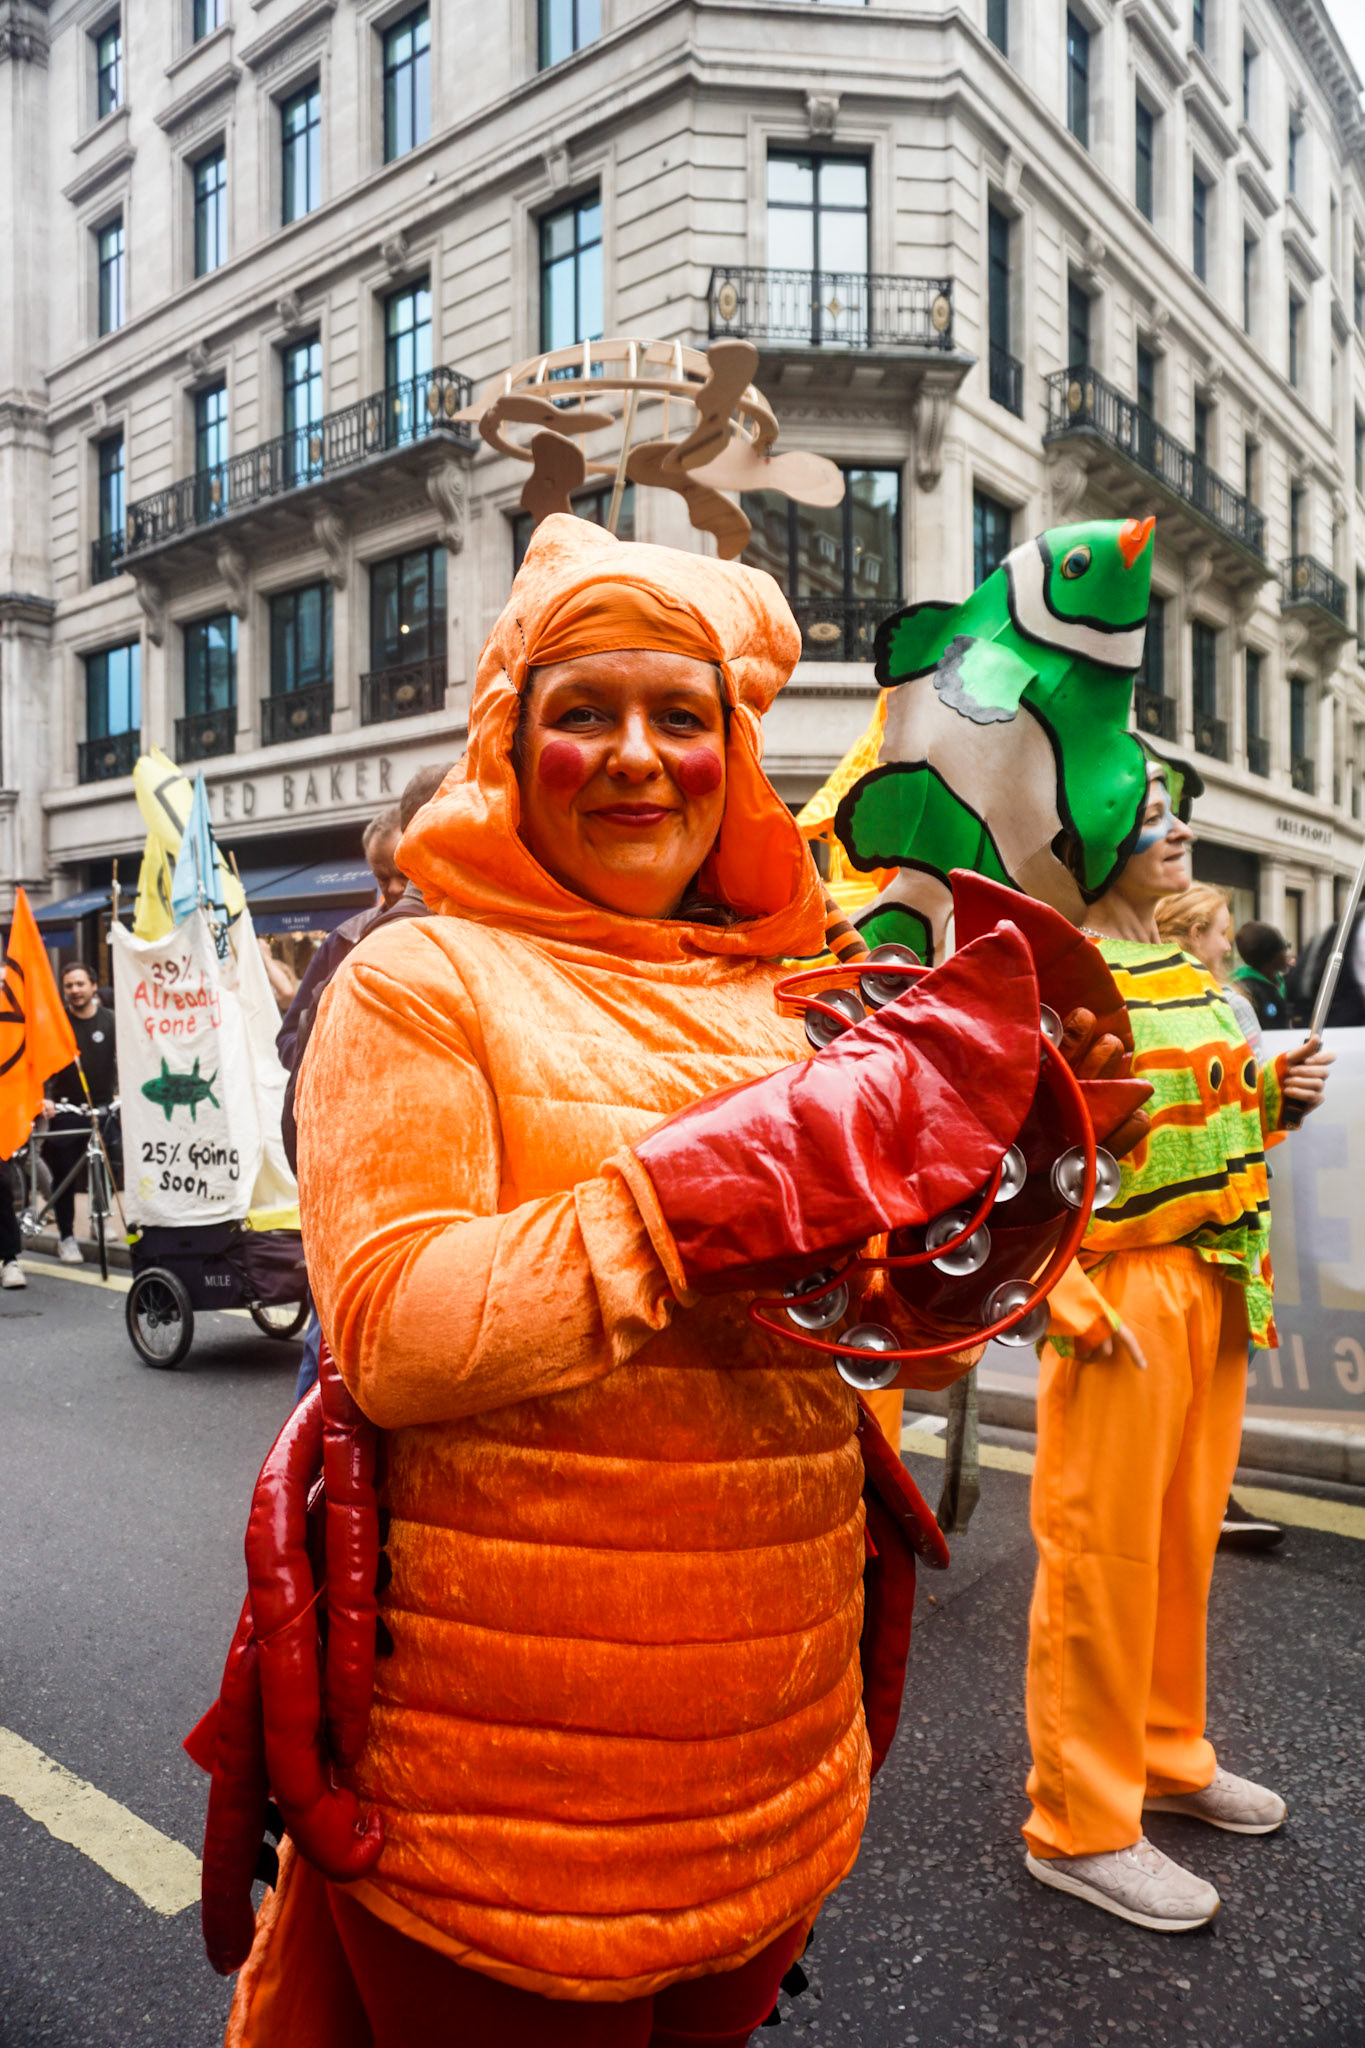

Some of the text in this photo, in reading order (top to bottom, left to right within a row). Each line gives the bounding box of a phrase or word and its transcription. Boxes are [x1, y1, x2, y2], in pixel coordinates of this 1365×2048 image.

[283, 757, 392, 810] BAKER
[151, 953, 193, 988] 39%
[133, 969, 222, 1029] Already
[142, 1141, 240, 1181] 25% Going
[204, 1275, 232, 1288] MULE
